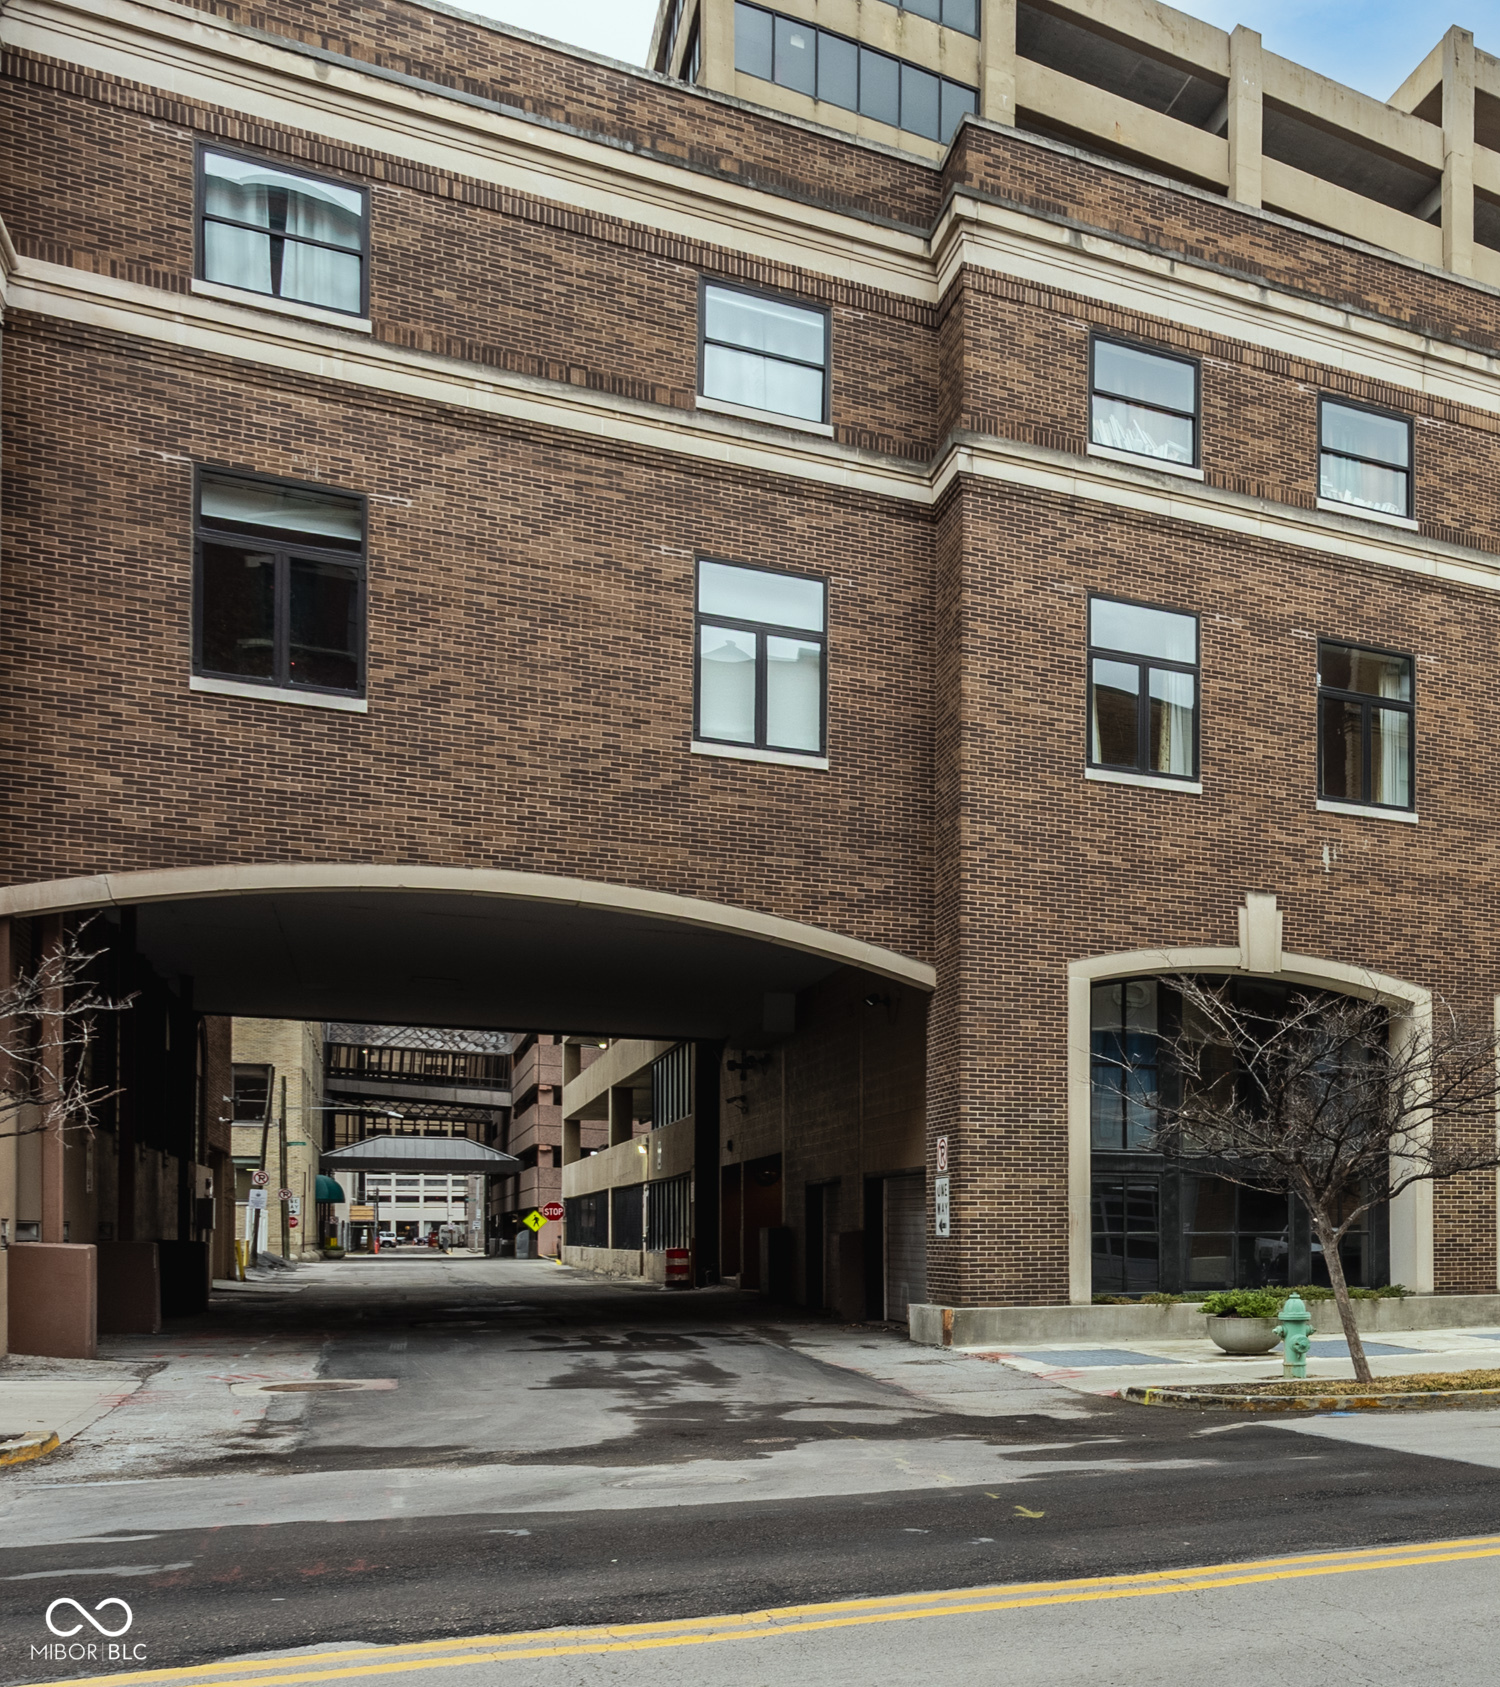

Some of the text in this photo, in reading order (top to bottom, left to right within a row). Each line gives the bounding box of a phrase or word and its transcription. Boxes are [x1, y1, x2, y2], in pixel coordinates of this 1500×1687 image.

[937, 1183, 948, 1198] ONE
[544, 1207, 564, 1216] STOP
[937, 1202, 948, 1216] WAY
